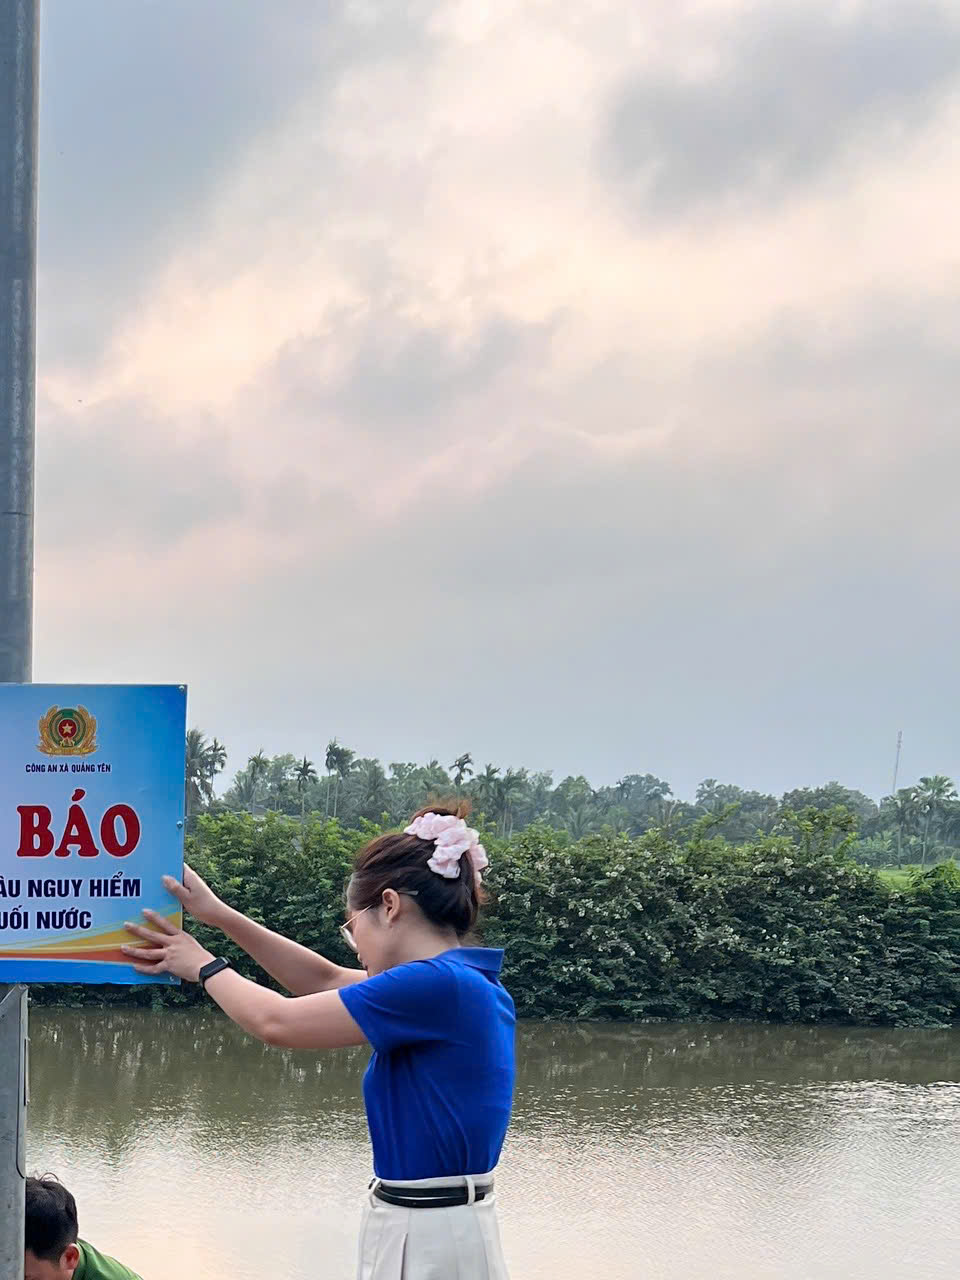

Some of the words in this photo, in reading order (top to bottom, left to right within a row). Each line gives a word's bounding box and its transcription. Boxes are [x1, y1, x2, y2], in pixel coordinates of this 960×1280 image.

[25, 762, 46, 773] CÔNG
[47, 764, 58, 773] AN
[71, 761, 96, 774] QUẢNG
[97, 762, 111, 773] YÊN
[17, 789, 141, 858] BÁO
[27, 879, 83, 898] NGUY
[89, 871, 141, 898] HIỂM
[36, 907, 92, 930] NƯỚC
